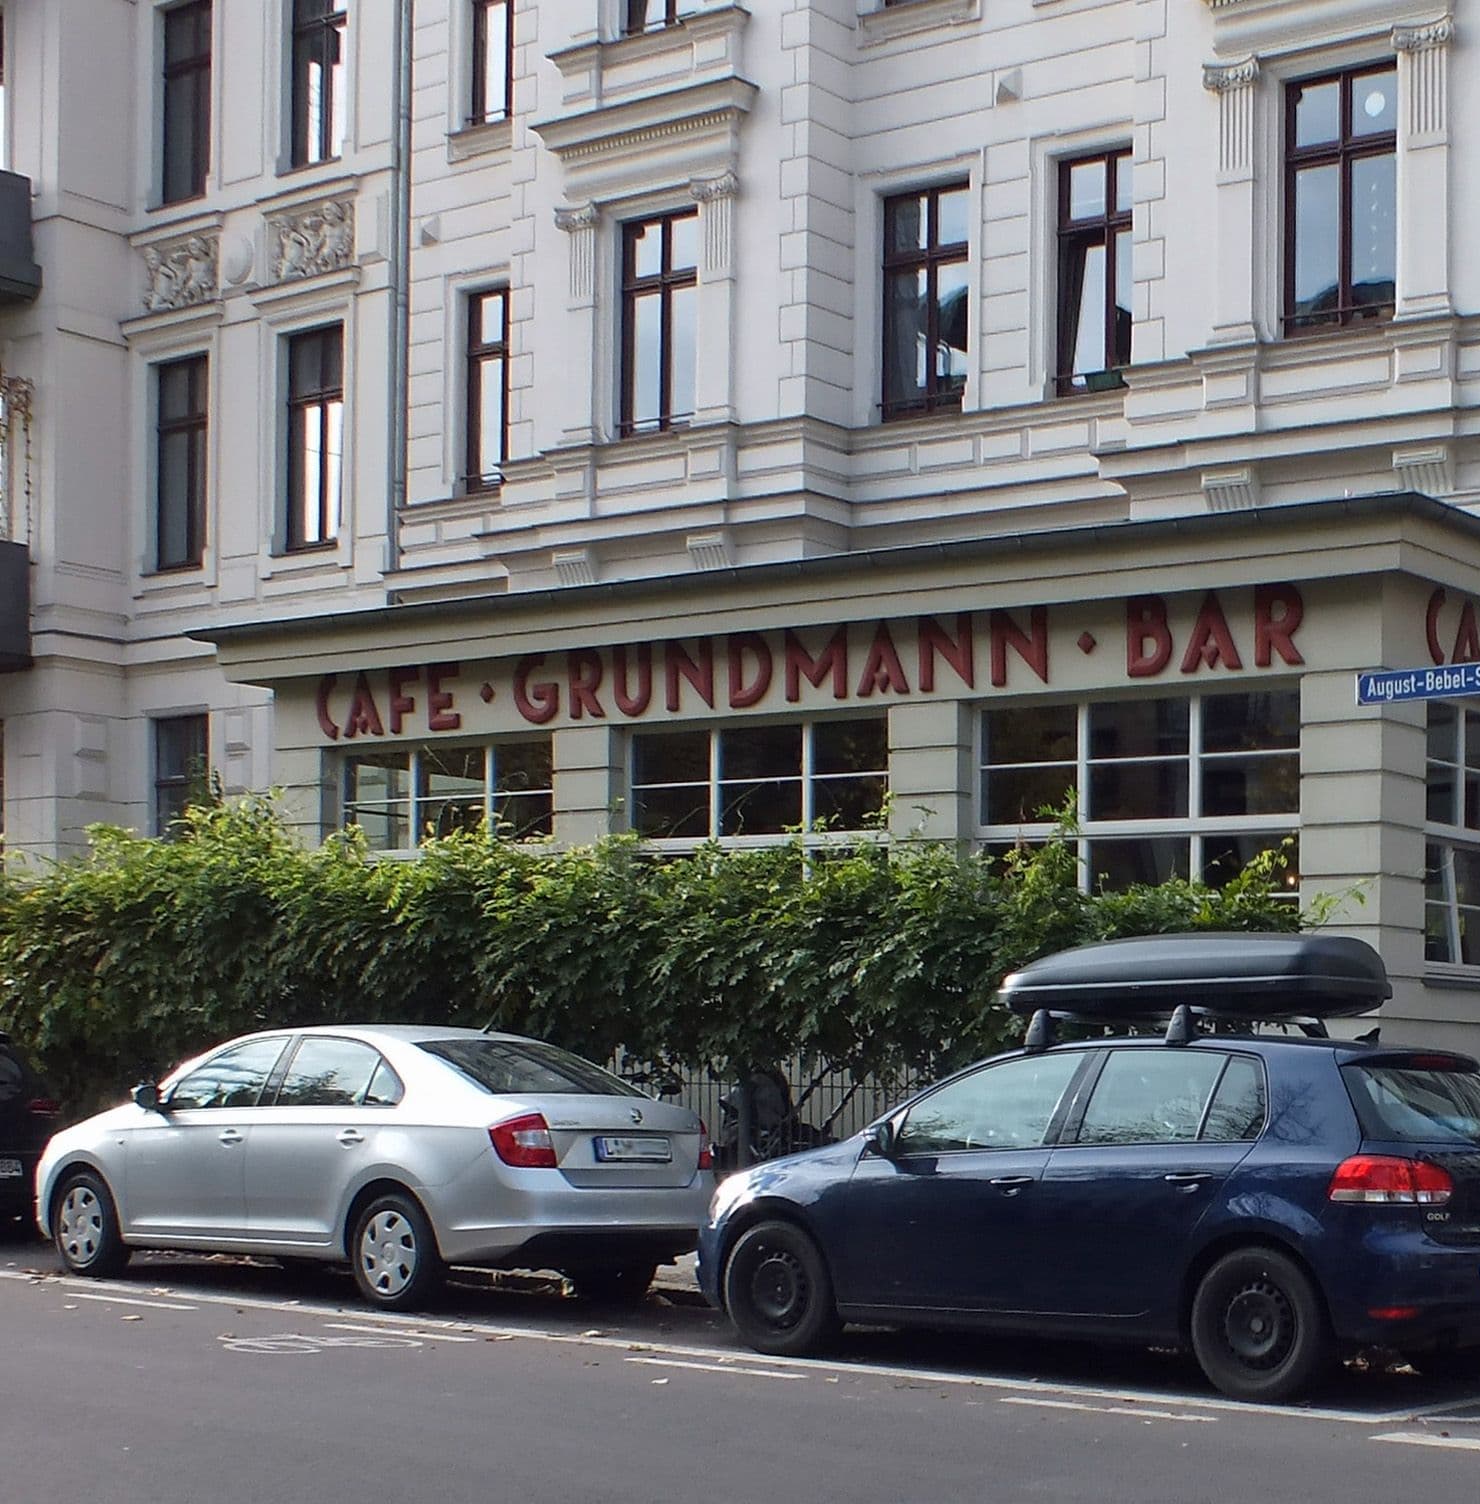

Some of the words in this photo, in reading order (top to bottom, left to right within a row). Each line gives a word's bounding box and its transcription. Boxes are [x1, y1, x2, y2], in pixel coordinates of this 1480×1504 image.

[316, 663, 461, 741] CAFE
[513, 605, 1048, 725] GRUNDMANN
[1126, 583, 1305, 678] BAR
[1426, 1212, 1450, 1221] GOLF
